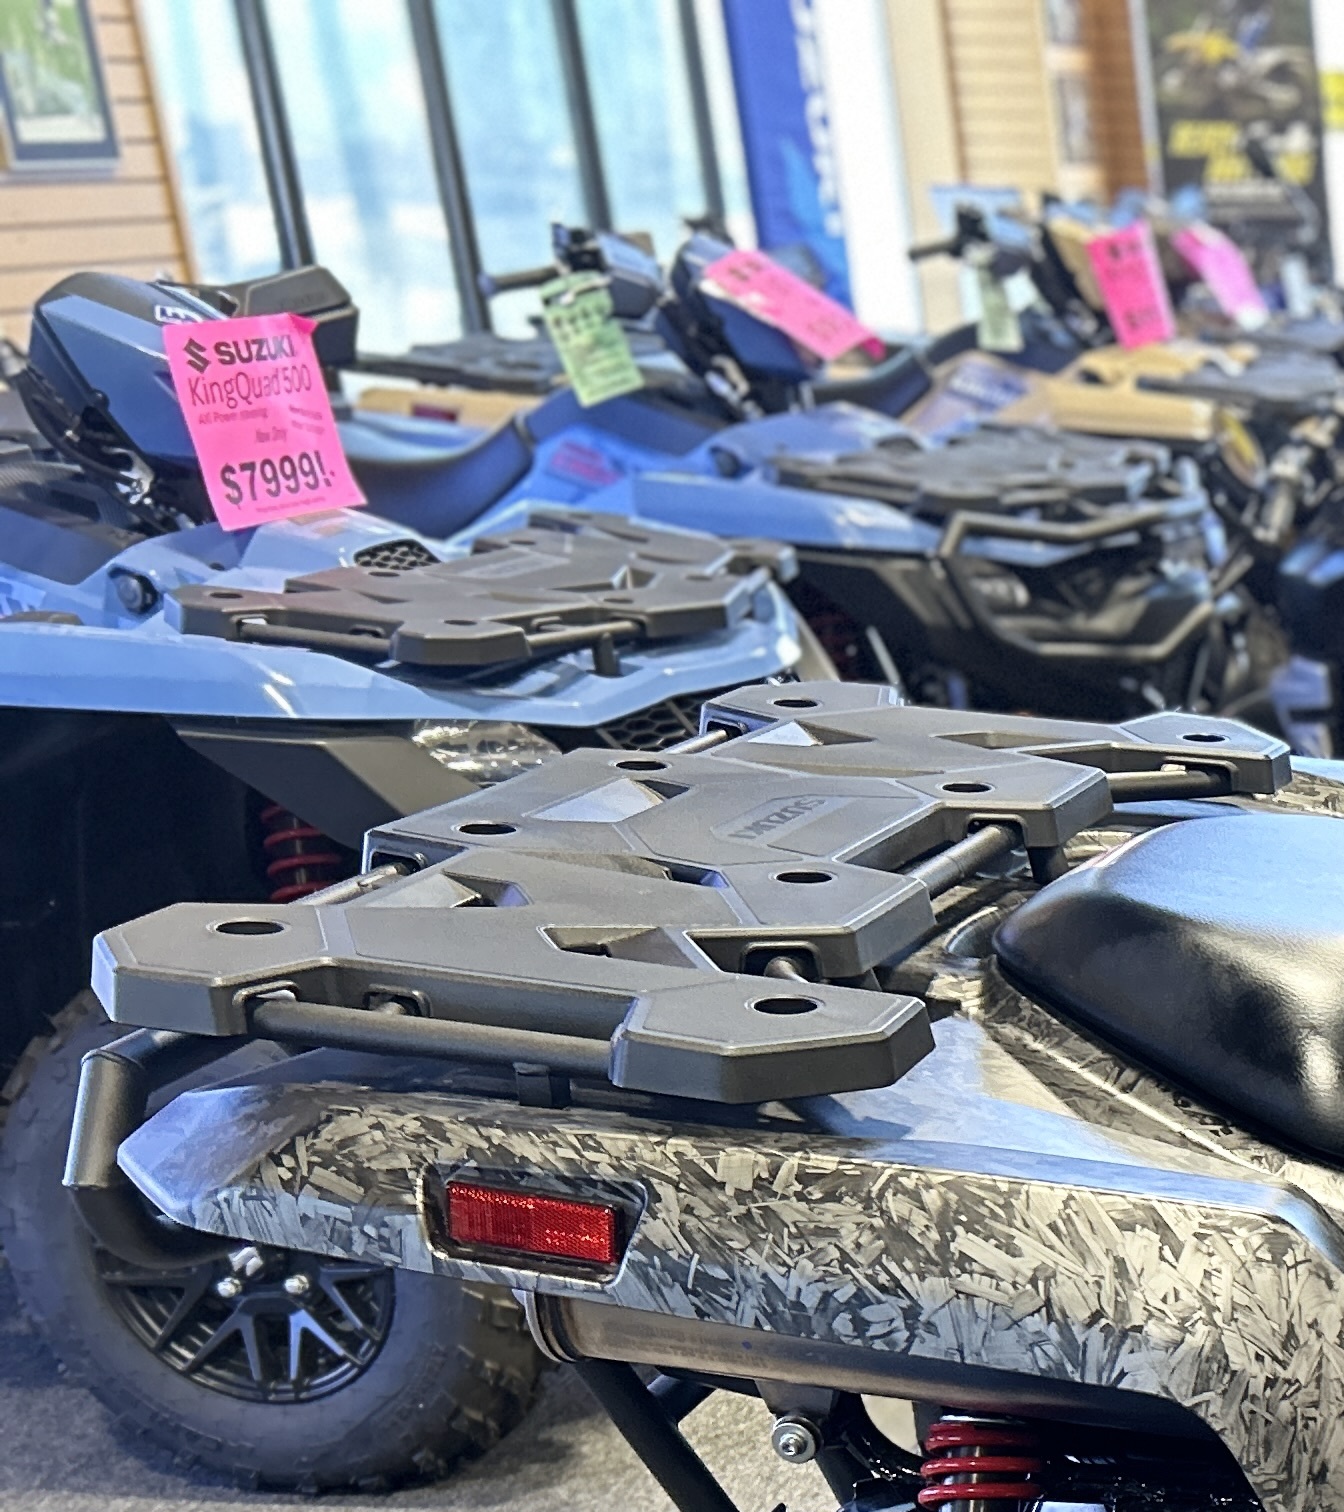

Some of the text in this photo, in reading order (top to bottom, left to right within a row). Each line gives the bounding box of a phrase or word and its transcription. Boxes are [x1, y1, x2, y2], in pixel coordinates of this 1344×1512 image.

[213, 334, 296, 366] SUZUKI
[188, 363, 312, 409] KingQuad 500
[221, 449, 332, 510] $7999!
[727, 797, 827, 841] SUZUKI
